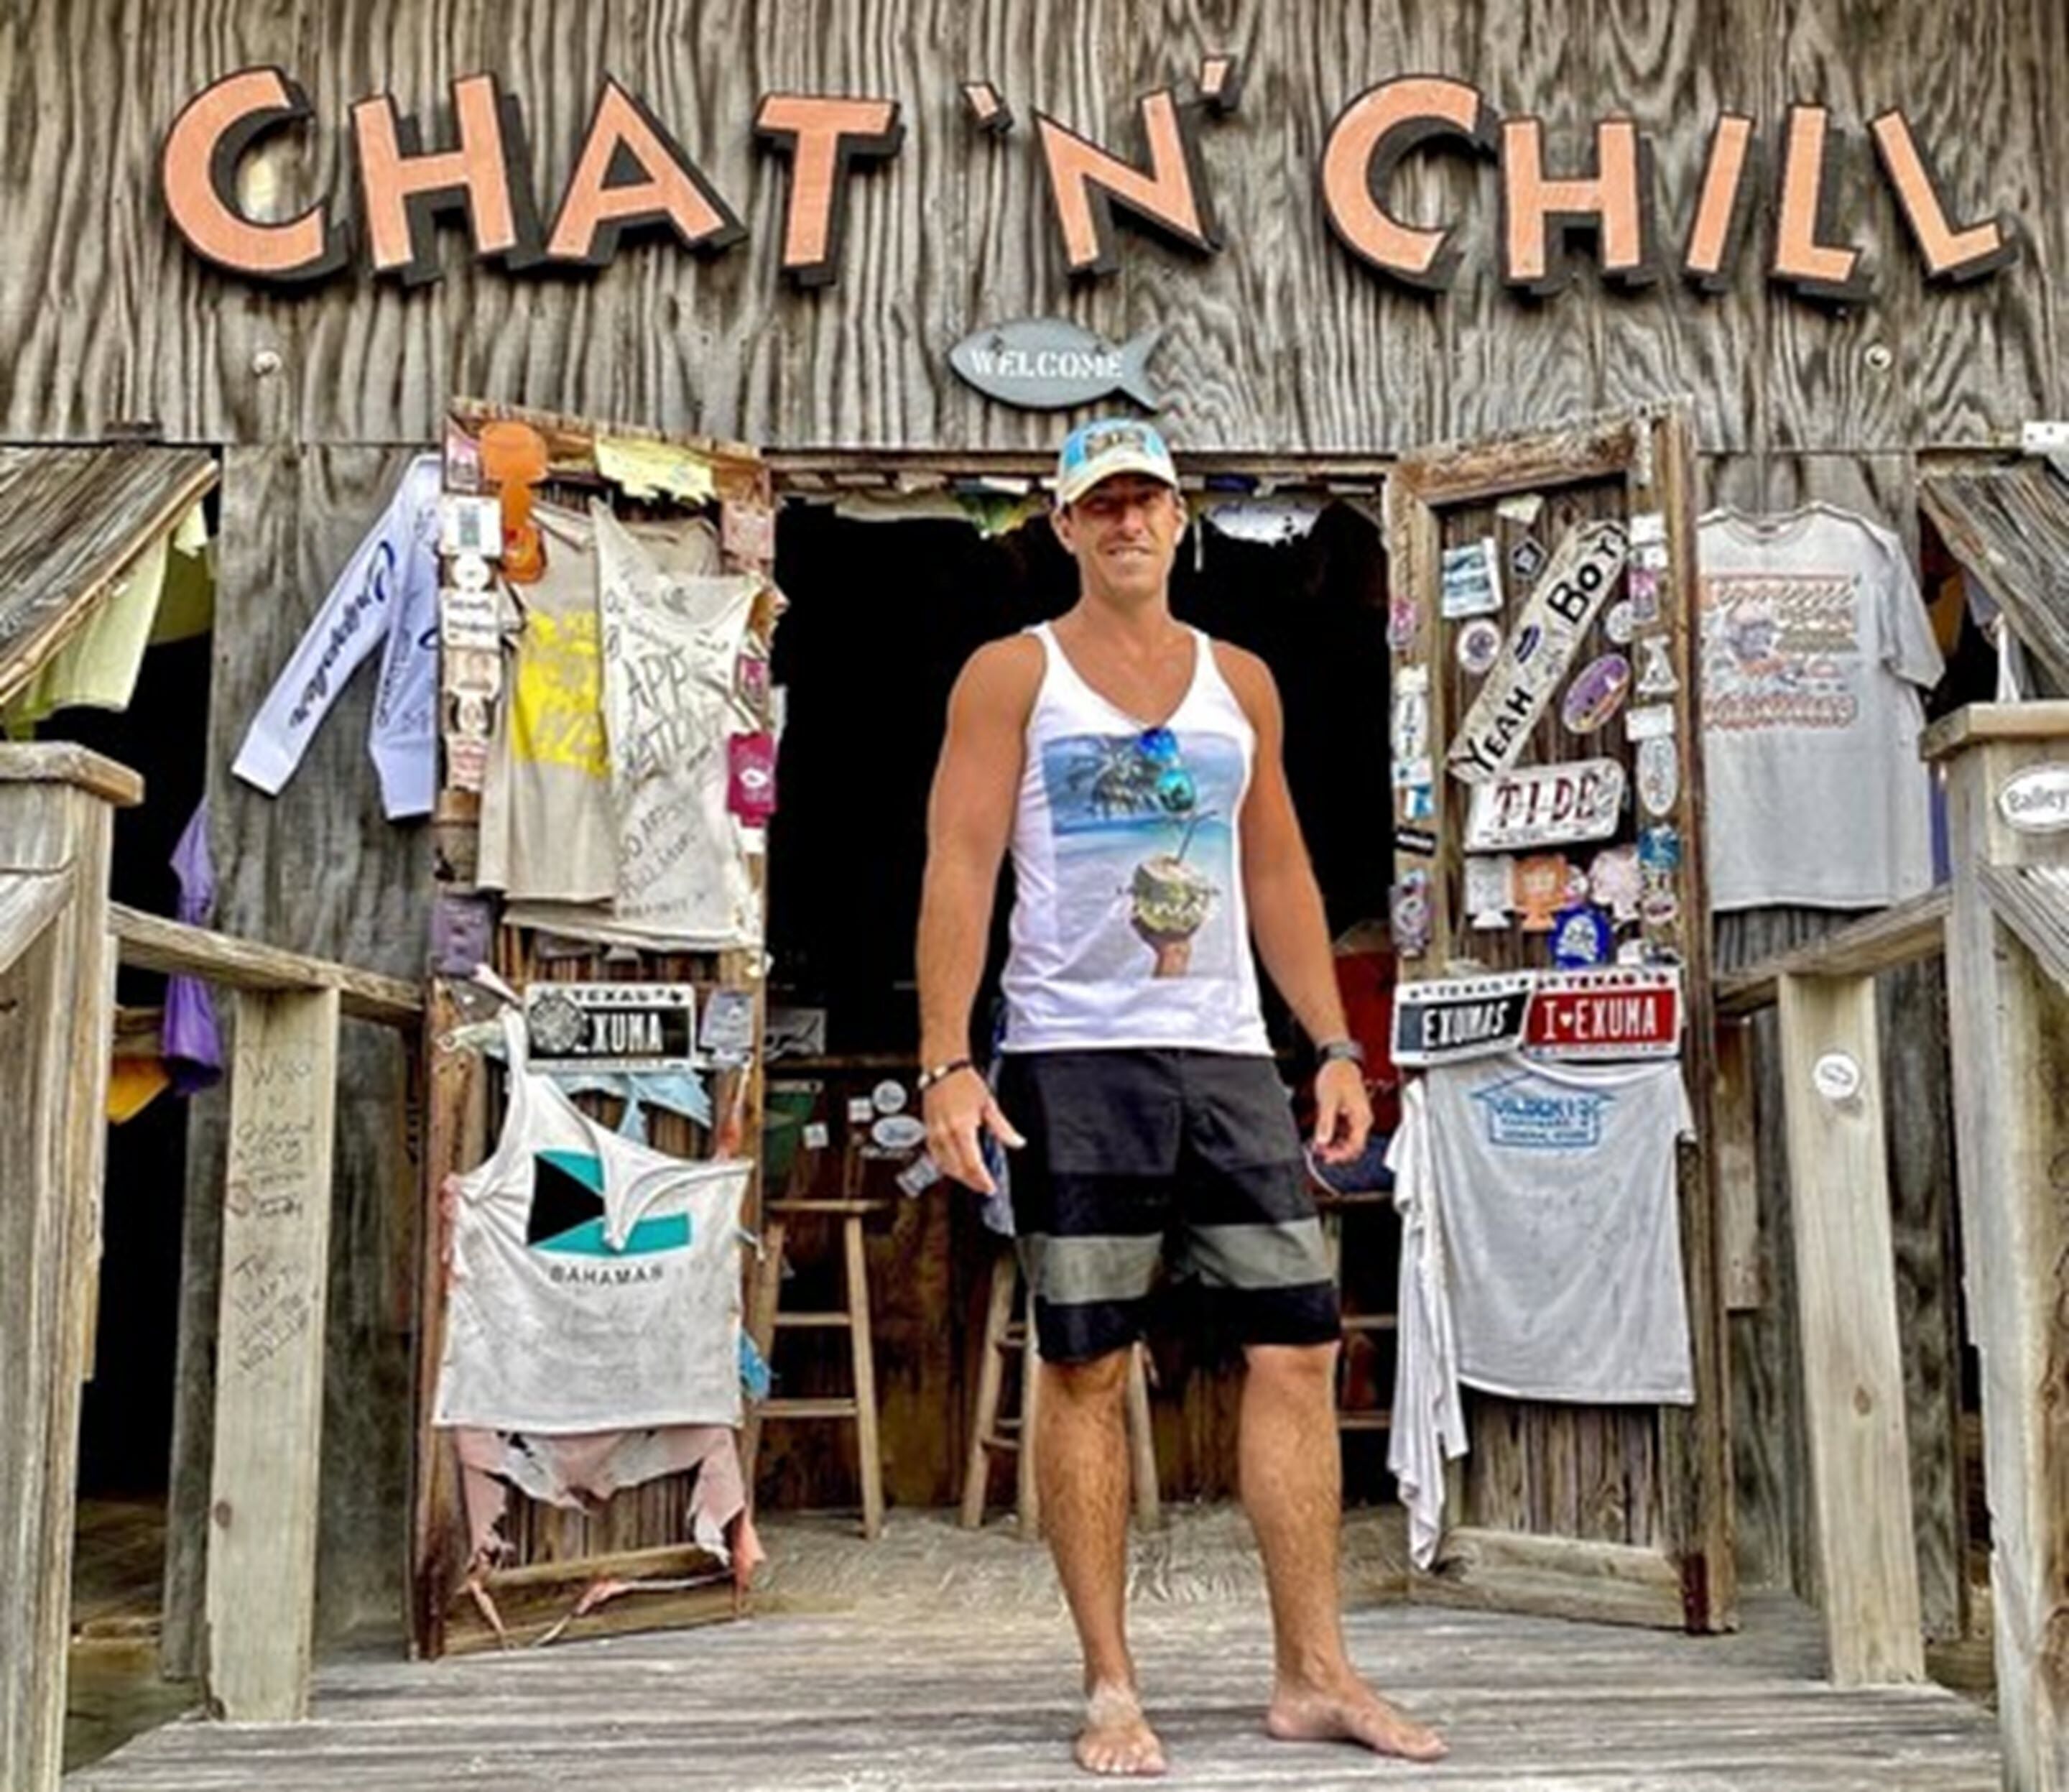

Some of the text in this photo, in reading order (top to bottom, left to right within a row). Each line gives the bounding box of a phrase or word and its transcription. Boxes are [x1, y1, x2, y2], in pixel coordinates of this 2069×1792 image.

[162, 65, 904, 280] CHAT
[1322, 72, 2013, 293] CHILL
[971, 348, 1125, 379] WELCOME
[1456, 687, 1534, 773] YEAH
[1546, 537, 1619, 624] BOY
[1494, 770, 1600, 828] TIDE
[573, 989, 650, 1002] TEXAS
[1565, 973, 1636, 989] TEXAS
[1542, 997, 1657, 1040] I EXUMA
[550, 1265, 664, 1285] BAHAMAS
